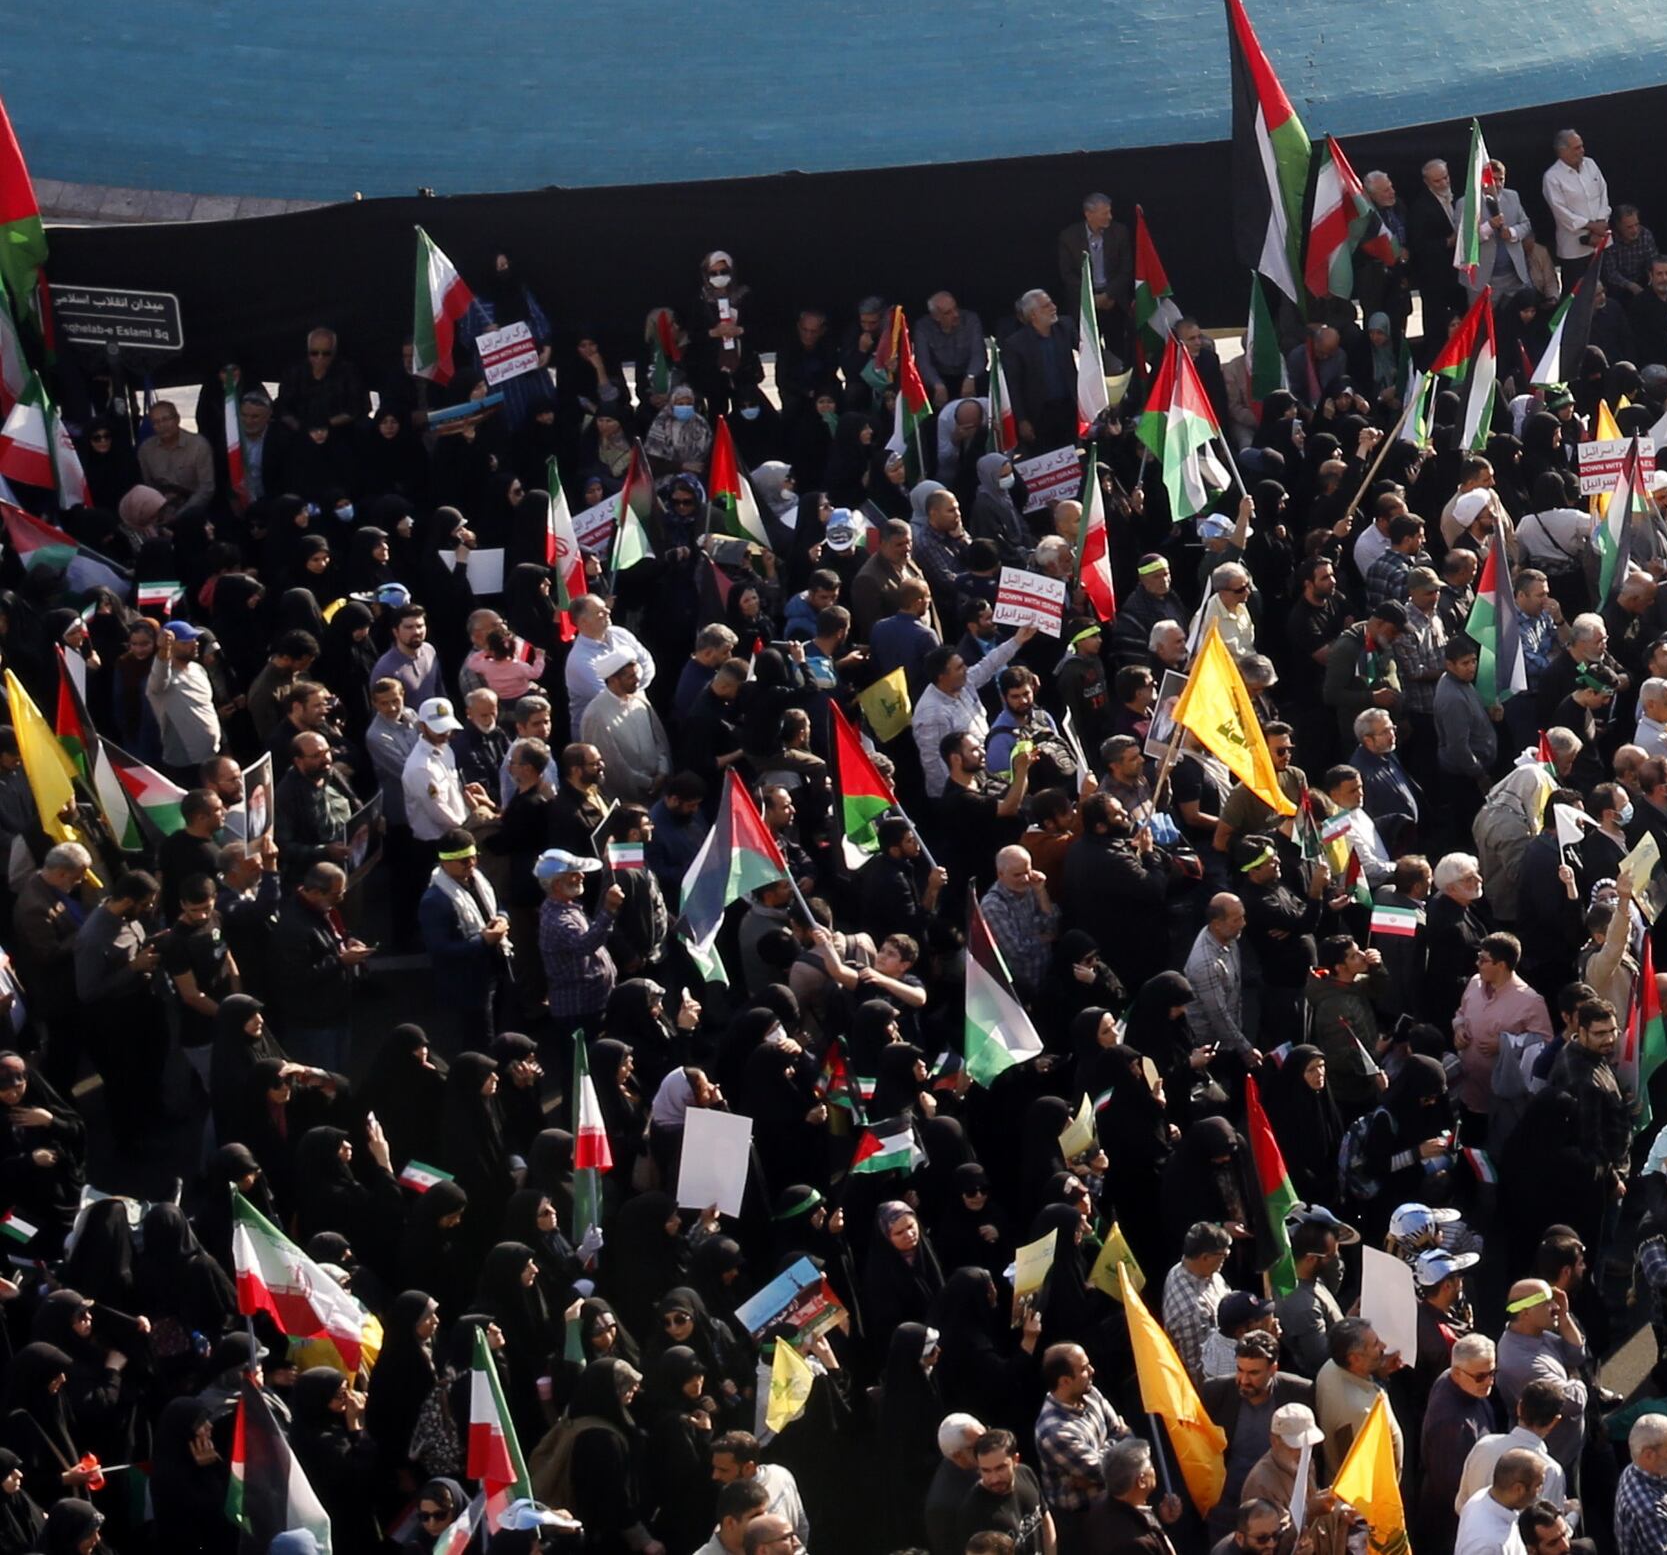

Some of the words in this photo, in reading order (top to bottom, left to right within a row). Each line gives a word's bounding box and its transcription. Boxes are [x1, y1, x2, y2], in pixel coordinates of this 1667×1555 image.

[92, 296, 128, 308] انقلاب
[131, 298, 165, 313] میدان
[115, 325, 152, 339] Eslami
[154, 328, 170, 342] Sq
[1581, 444, 1614, 460] اسرائیل
[1580, 464, 1604, 474] DOWN
